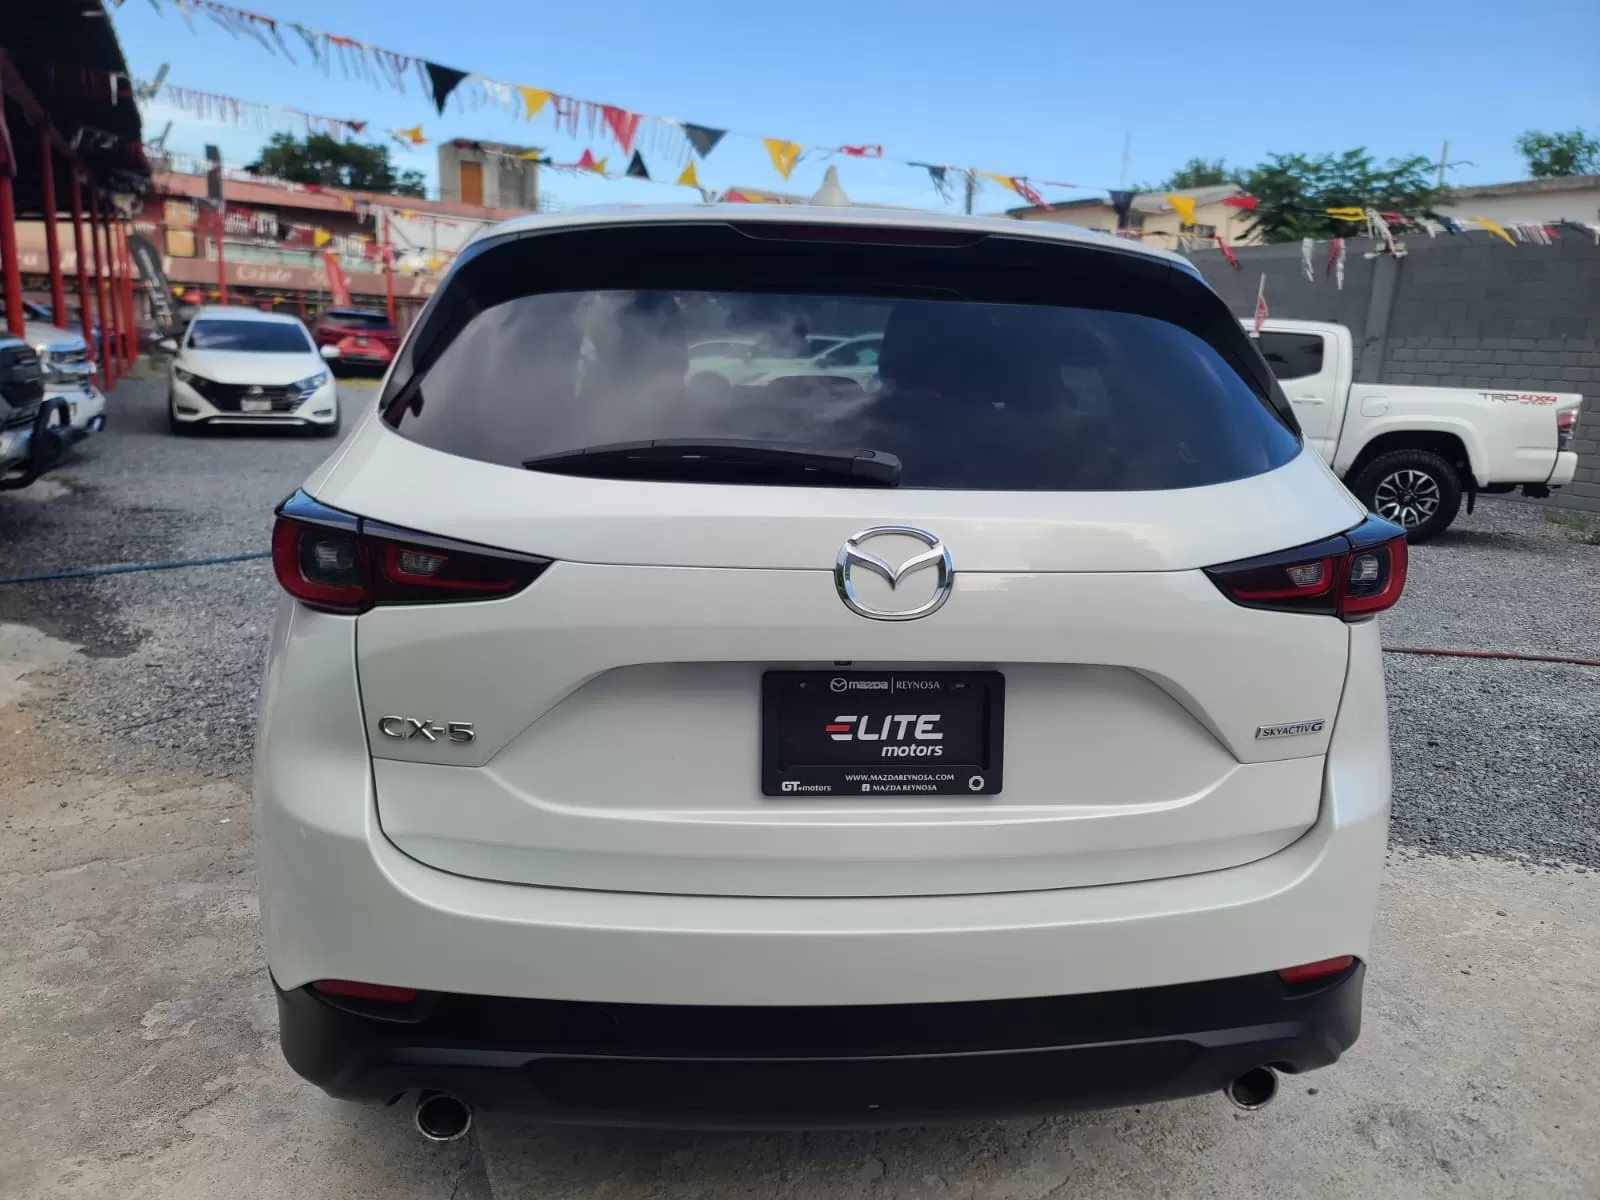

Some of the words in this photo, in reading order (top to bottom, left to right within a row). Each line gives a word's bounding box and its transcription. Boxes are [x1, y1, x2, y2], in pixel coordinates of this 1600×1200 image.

[1478, 392, 1519, 402] TRD
[848, 681, 889, 690] mazda
[896, 680, 940, 690] REYNOSA
[378, 715, 476, 742] CX-5
[825, 714, 944, 741] ELITE
[881, 743, 944, 757] motors
[845, 774, 955, 782] WWW.MAZDAREYNOSA.COM
[872, 784, 902, 792] MAZDA
[902, 784, 937, 792] REYNOSA
